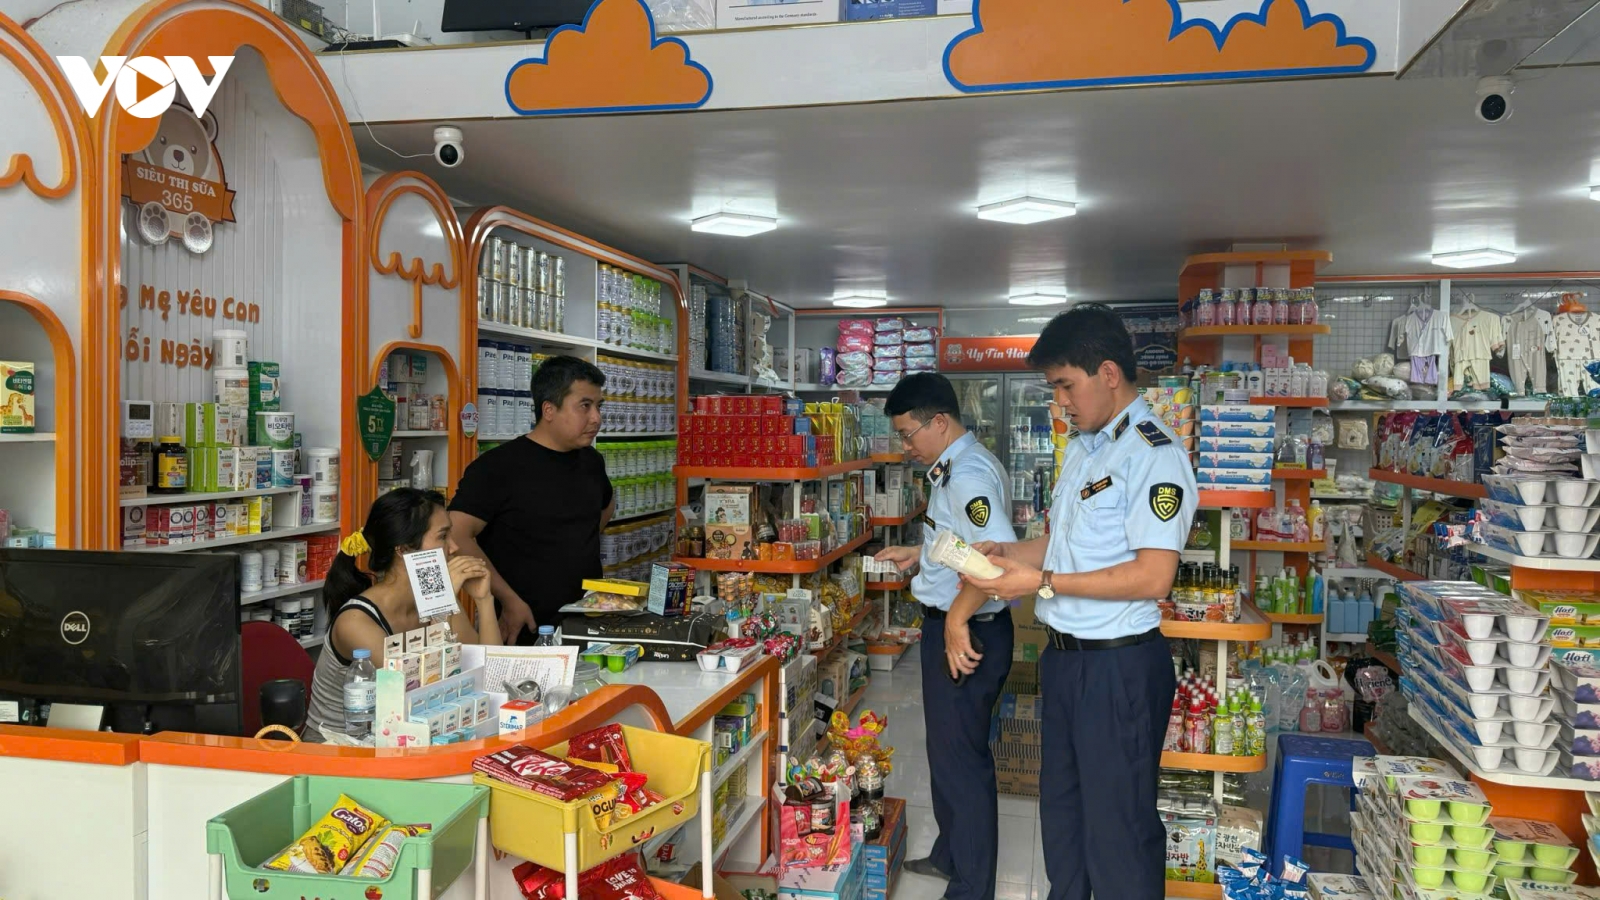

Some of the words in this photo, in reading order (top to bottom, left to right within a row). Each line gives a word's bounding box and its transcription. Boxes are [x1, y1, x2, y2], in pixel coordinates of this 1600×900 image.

[136, 166, 166, 184] SIÊU
[169, 176, 190, 193] THỊ
[192, 181, 216, 197] SỮA
[162, 190, 193, 211] 365
[140, 284, 171, 321] Mẹ
[177, 288, 217, 318] Yêu
[223, 297, 260, 324] Con
[120, 327, 150, 363] ỗi
[160, 338, 214, 371] Ngày
[966, 348, 984, 362] Uy
[1006, 347, 1030, 358] Hàn
[1016, 425, 1052, 433] HOAPHA
[1158, 487, 1176, 495] DMS
[969, 499, 983, 510] DMS
[64, 623, 87, 632] DELL
[333, 808, 368, 833] Gatos
[604, 870, 630, 885] LOVE
[612, 877, 637, 891] SHARE
